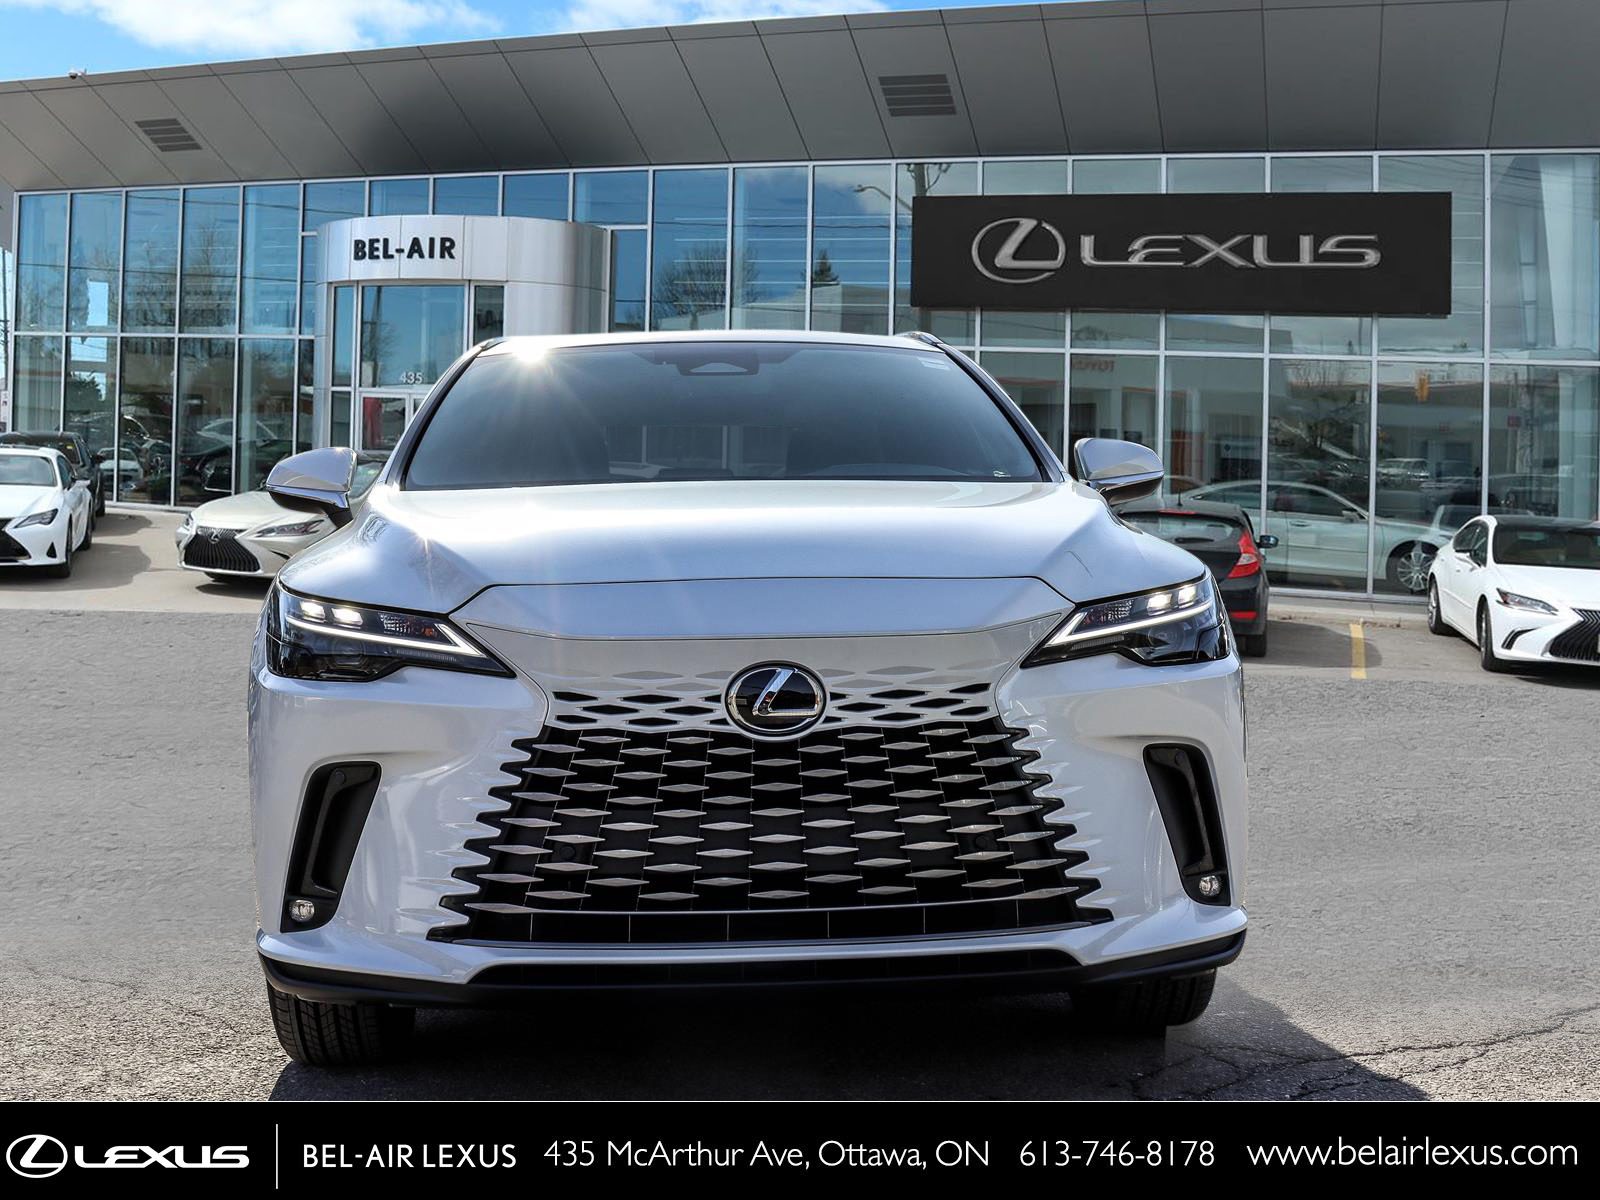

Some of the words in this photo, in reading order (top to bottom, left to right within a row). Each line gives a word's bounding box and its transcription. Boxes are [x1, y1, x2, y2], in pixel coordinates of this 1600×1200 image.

[353, 237, 456, 261] BEL-AIR
[1079, 233, 1382, 269] LEXUS
[399, 370, 424, 385] 435
